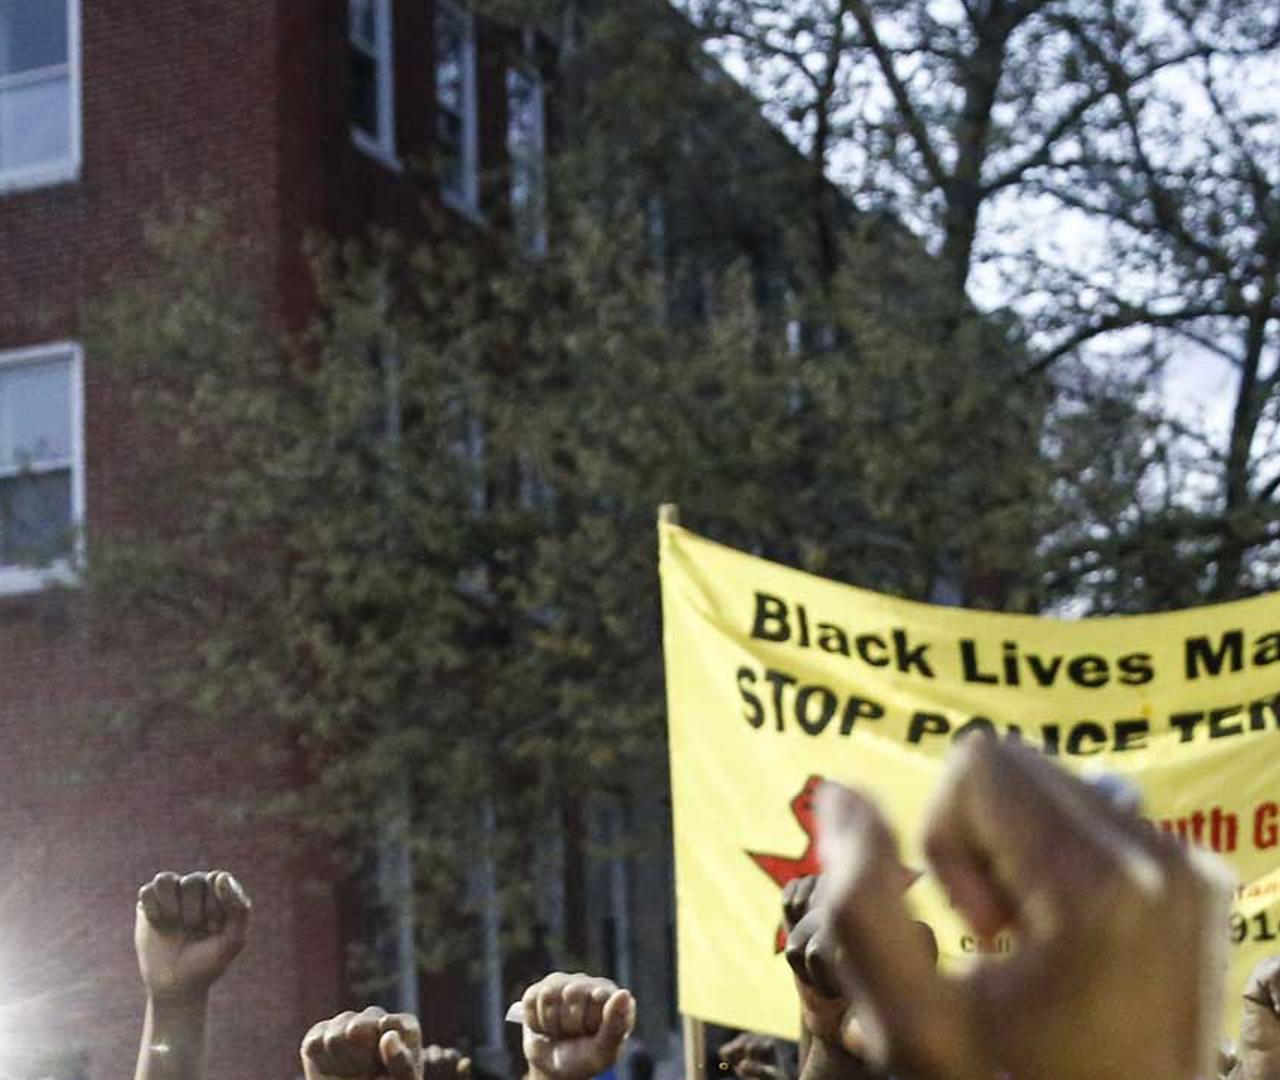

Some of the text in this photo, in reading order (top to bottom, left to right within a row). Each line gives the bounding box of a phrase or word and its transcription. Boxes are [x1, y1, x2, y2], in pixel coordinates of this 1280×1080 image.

[750, 591, 935, 679] Black
[959, 638, 1155, 688] Lives
[736, 665, 886, 737] STOP
[906, 712, 1150, 756] PICE
